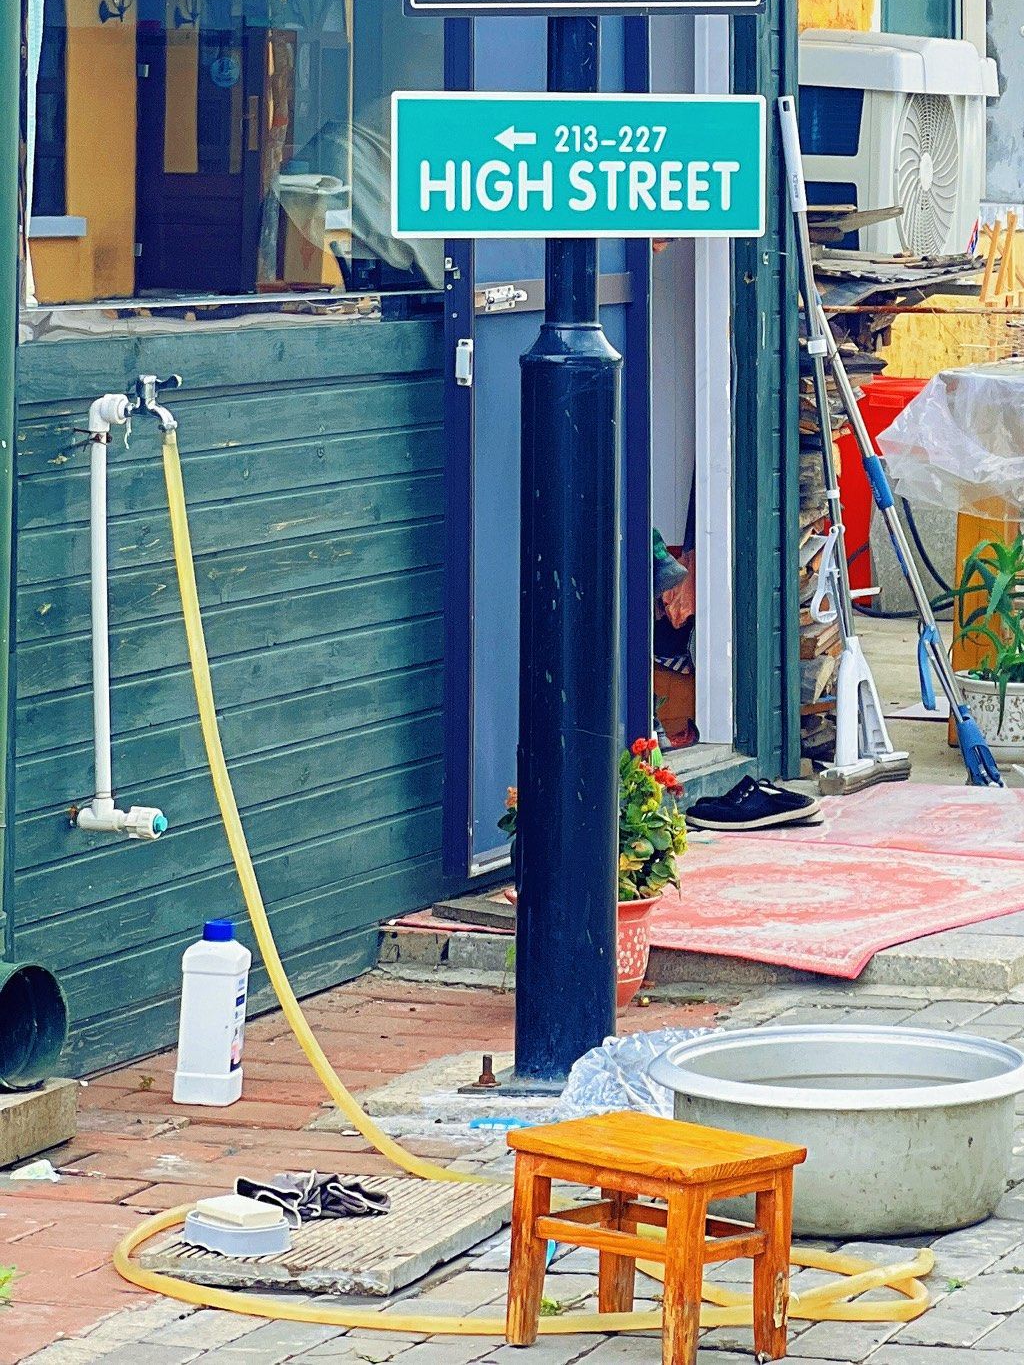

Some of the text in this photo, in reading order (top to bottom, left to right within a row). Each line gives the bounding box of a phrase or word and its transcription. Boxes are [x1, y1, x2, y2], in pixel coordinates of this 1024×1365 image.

[554, 125, 668, 153] 213-227
[419, 160, 553, 212] HIGH
[568, 160, 741, 212] STREET
